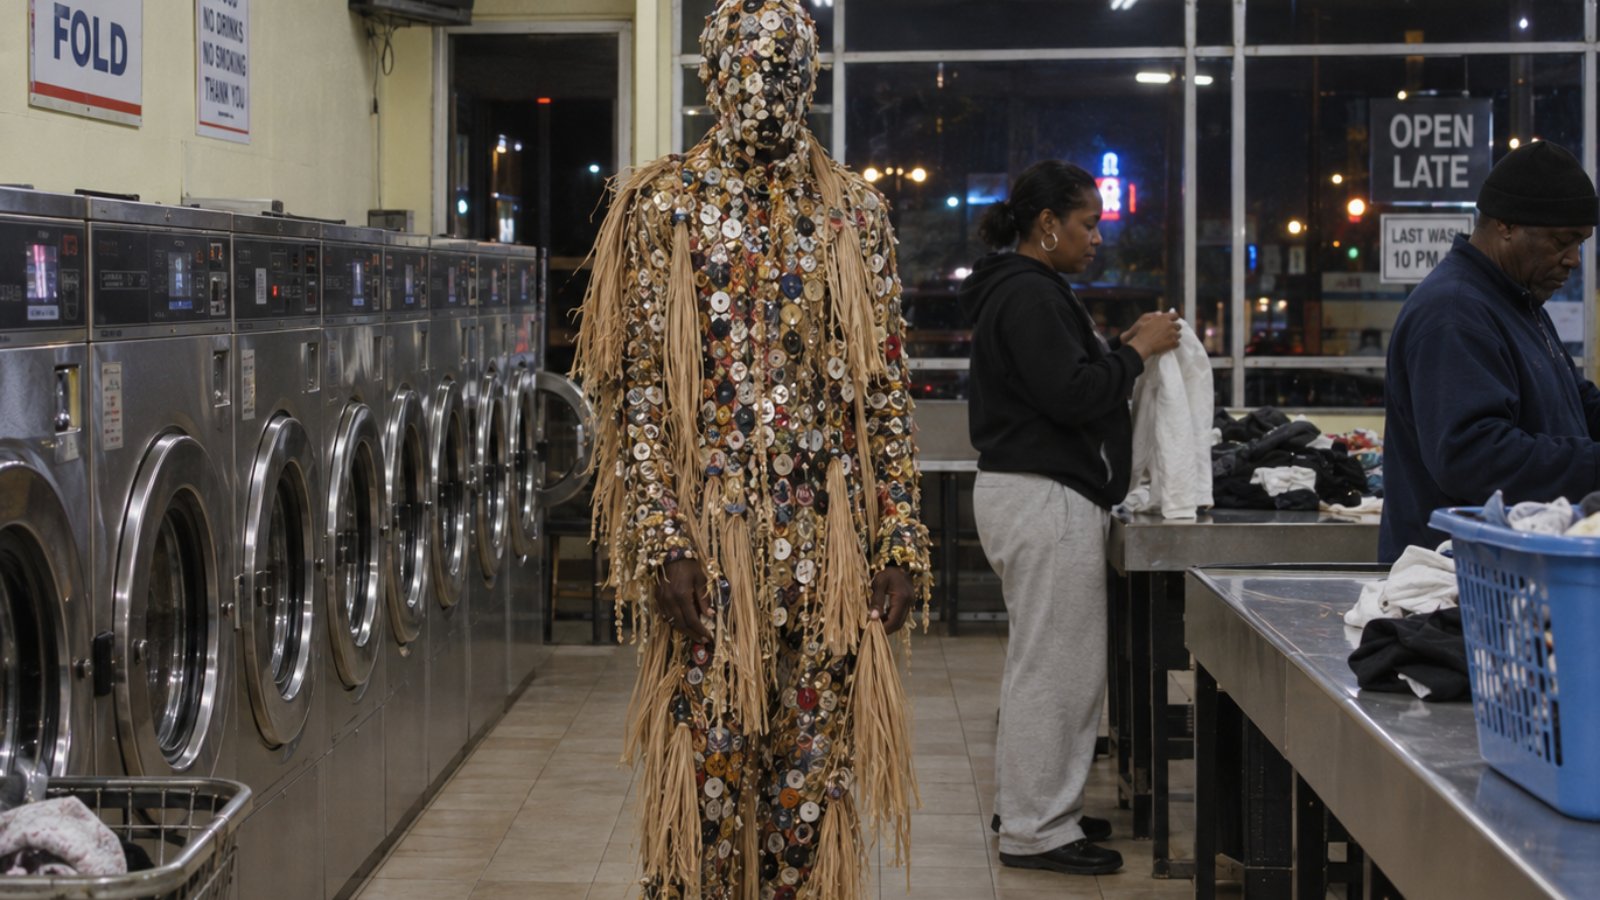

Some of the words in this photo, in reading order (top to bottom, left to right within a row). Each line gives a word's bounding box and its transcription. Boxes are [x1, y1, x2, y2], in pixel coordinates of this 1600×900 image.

[54, 2, 127, 76] FOLD
[203, 6, 214, 32] NO
[217, 12, 243, 44] DRINKS
[203, 41, 214, 66] NO
[216, 45, 245, 77] SMOKING
[205, 76, 229, 104] THANK
[231, 84, 244, 109] YOU
[1389, 114, 1474, 148] OPEN
[1393, 155, 1469, 188] LATE
[1392, 228, 1423, 243] LAST
[1394, 250, 1411, 268] 10
[1416, 250, 1438, 268] PM
